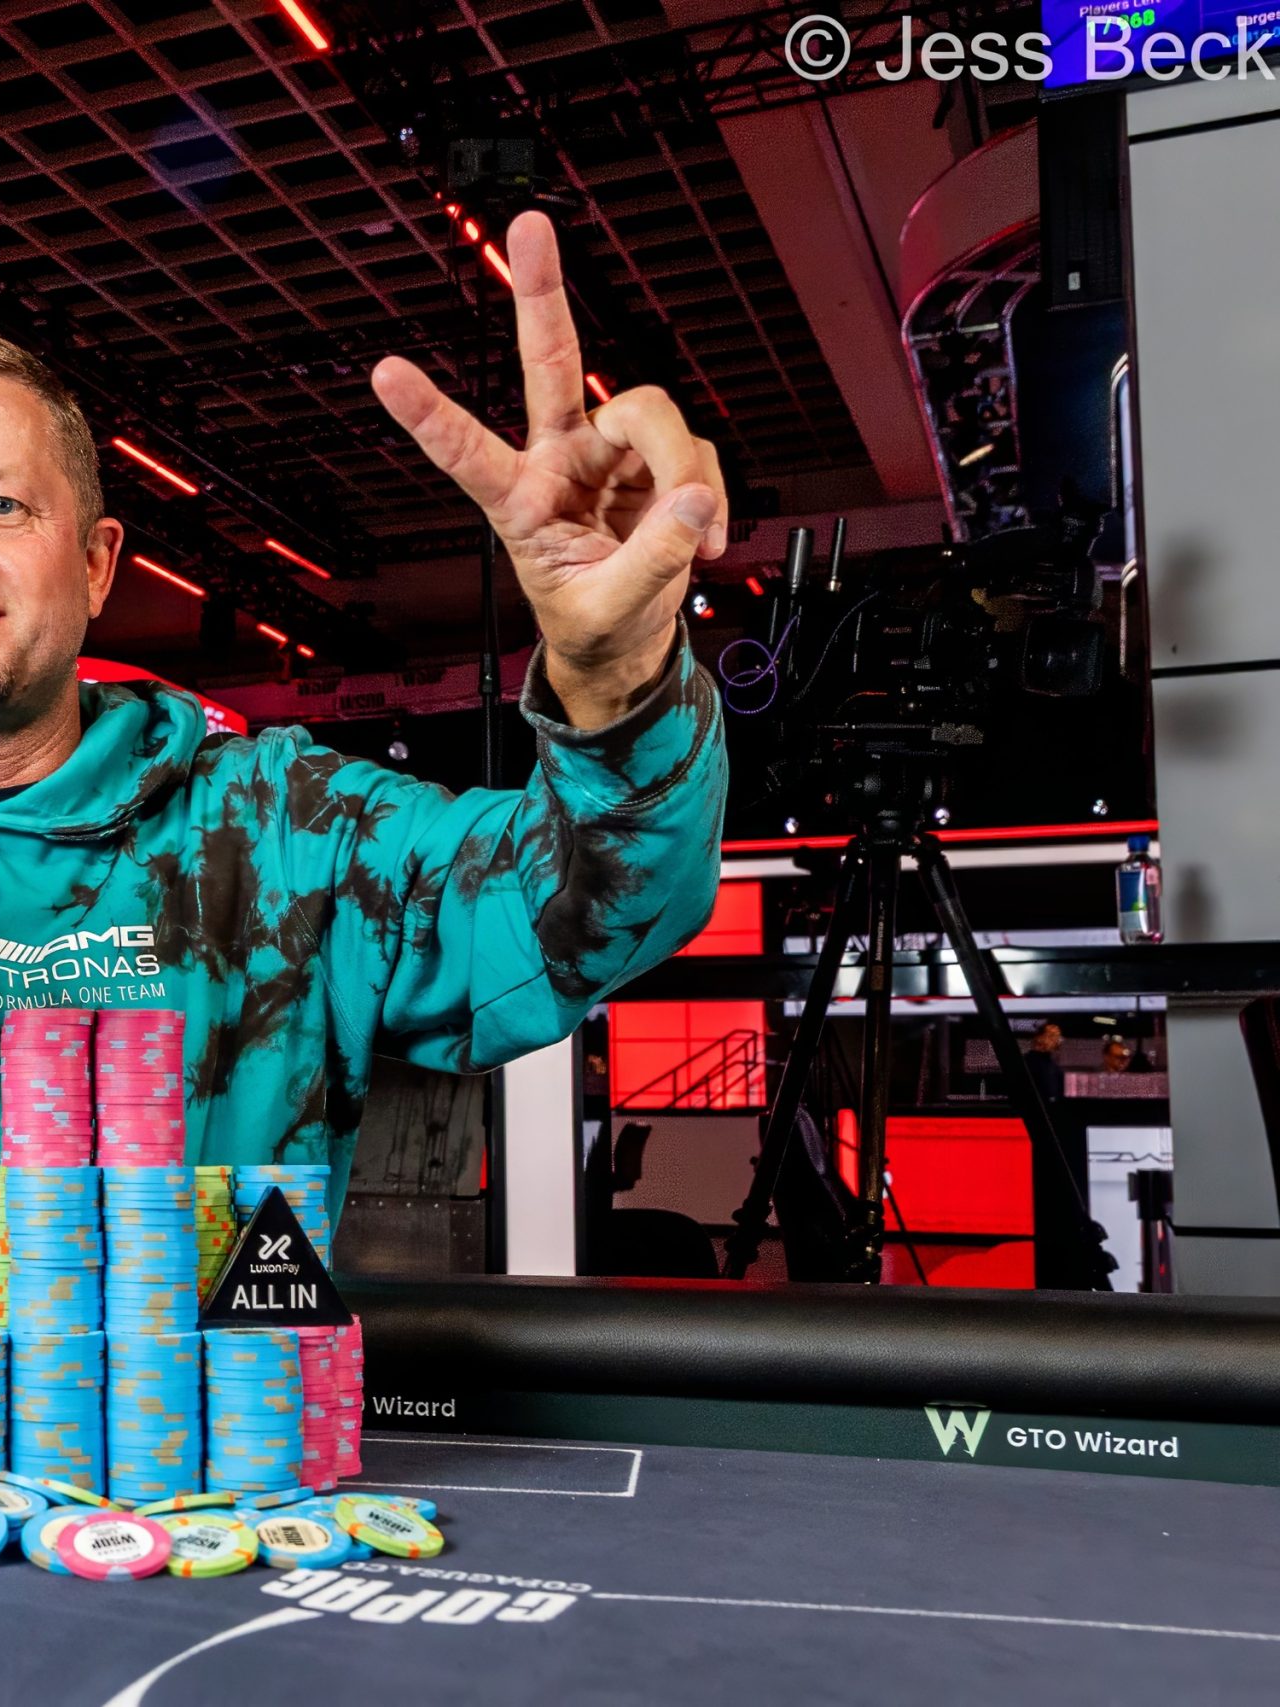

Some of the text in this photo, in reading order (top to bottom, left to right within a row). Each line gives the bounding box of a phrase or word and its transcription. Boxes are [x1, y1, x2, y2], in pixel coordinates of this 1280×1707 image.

[1080, 2, 1130, 18] Players
[35, 925, 155, 963] AMG
[79, 986, 113, 1004] ONE
[117, 982, 166, 1002] TEAM
[231, 1284, 318, 1310] ALL IN
[372, 1395, 456, 1418] Wizard
[1006, 1427, 1179, 1459] GTO Wizard
